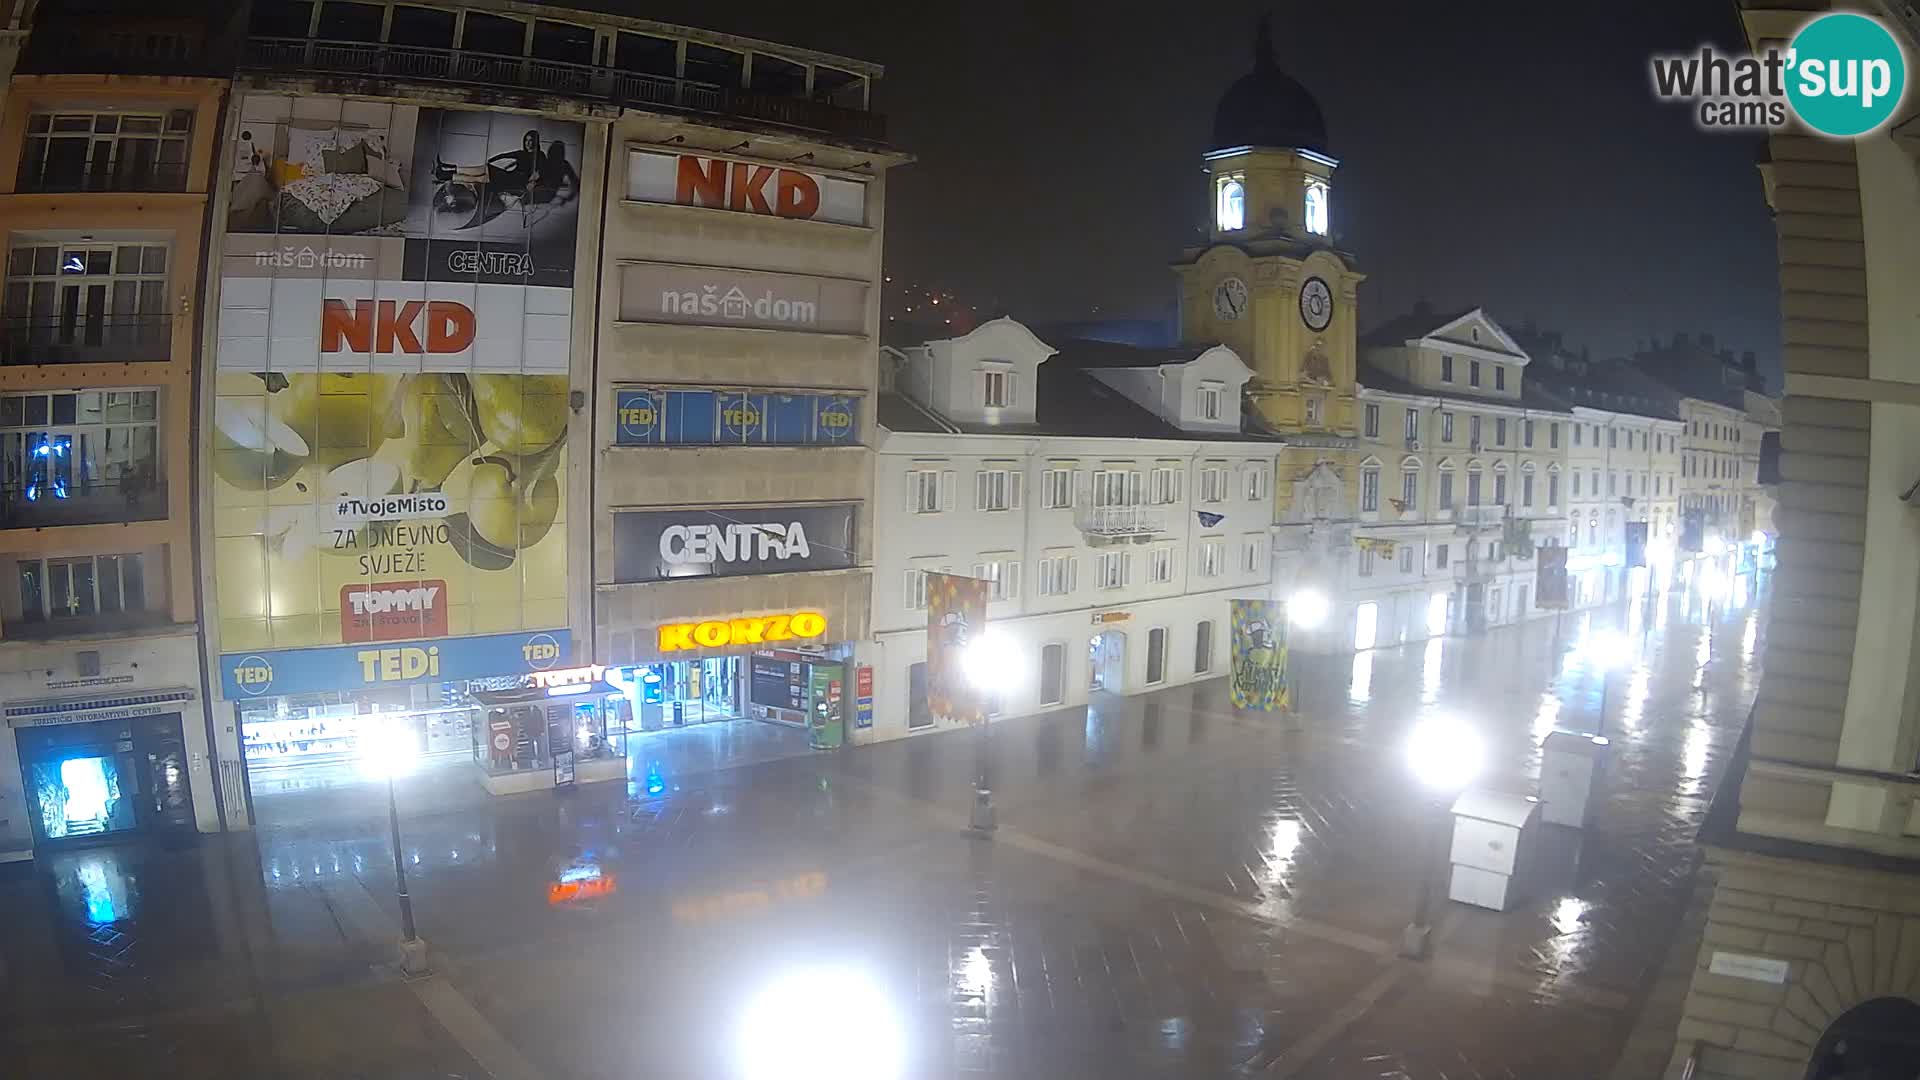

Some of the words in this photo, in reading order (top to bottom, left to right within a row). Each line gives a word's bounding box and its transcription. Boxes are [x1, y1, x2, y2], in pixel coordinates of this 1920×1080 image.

[676, 155, 820, 220] NKD
[319, 246, 365, 269] dom
[448, 250, 534, 275] CENTRA
[661, 285, 719, 316] naš
[754, 291, 816, 322] dom
[321, 298, 477, 353] NKD
[619, 409, 657, 425] TEDi
[723, 410, 760, 425] TEDi
[338, 496, 447, 517] #TvojeMisto
[333, 529, 358, 549] ZA
[369, 524, 450, 548] DNEVNO
[660, 521, 810, 563] CENTRA
[359, 547, 427, 576] SVJEŽE
[348, 586, 439, 615] TOMMY
[658, 612, 827, 652] KORZO
[357, 646, 439, 682] TEDi
[522, 644, 560, 661] TEDi
[234, 666, 273, 684] TEDi
[532, 664, 607, 688] TOMMY
